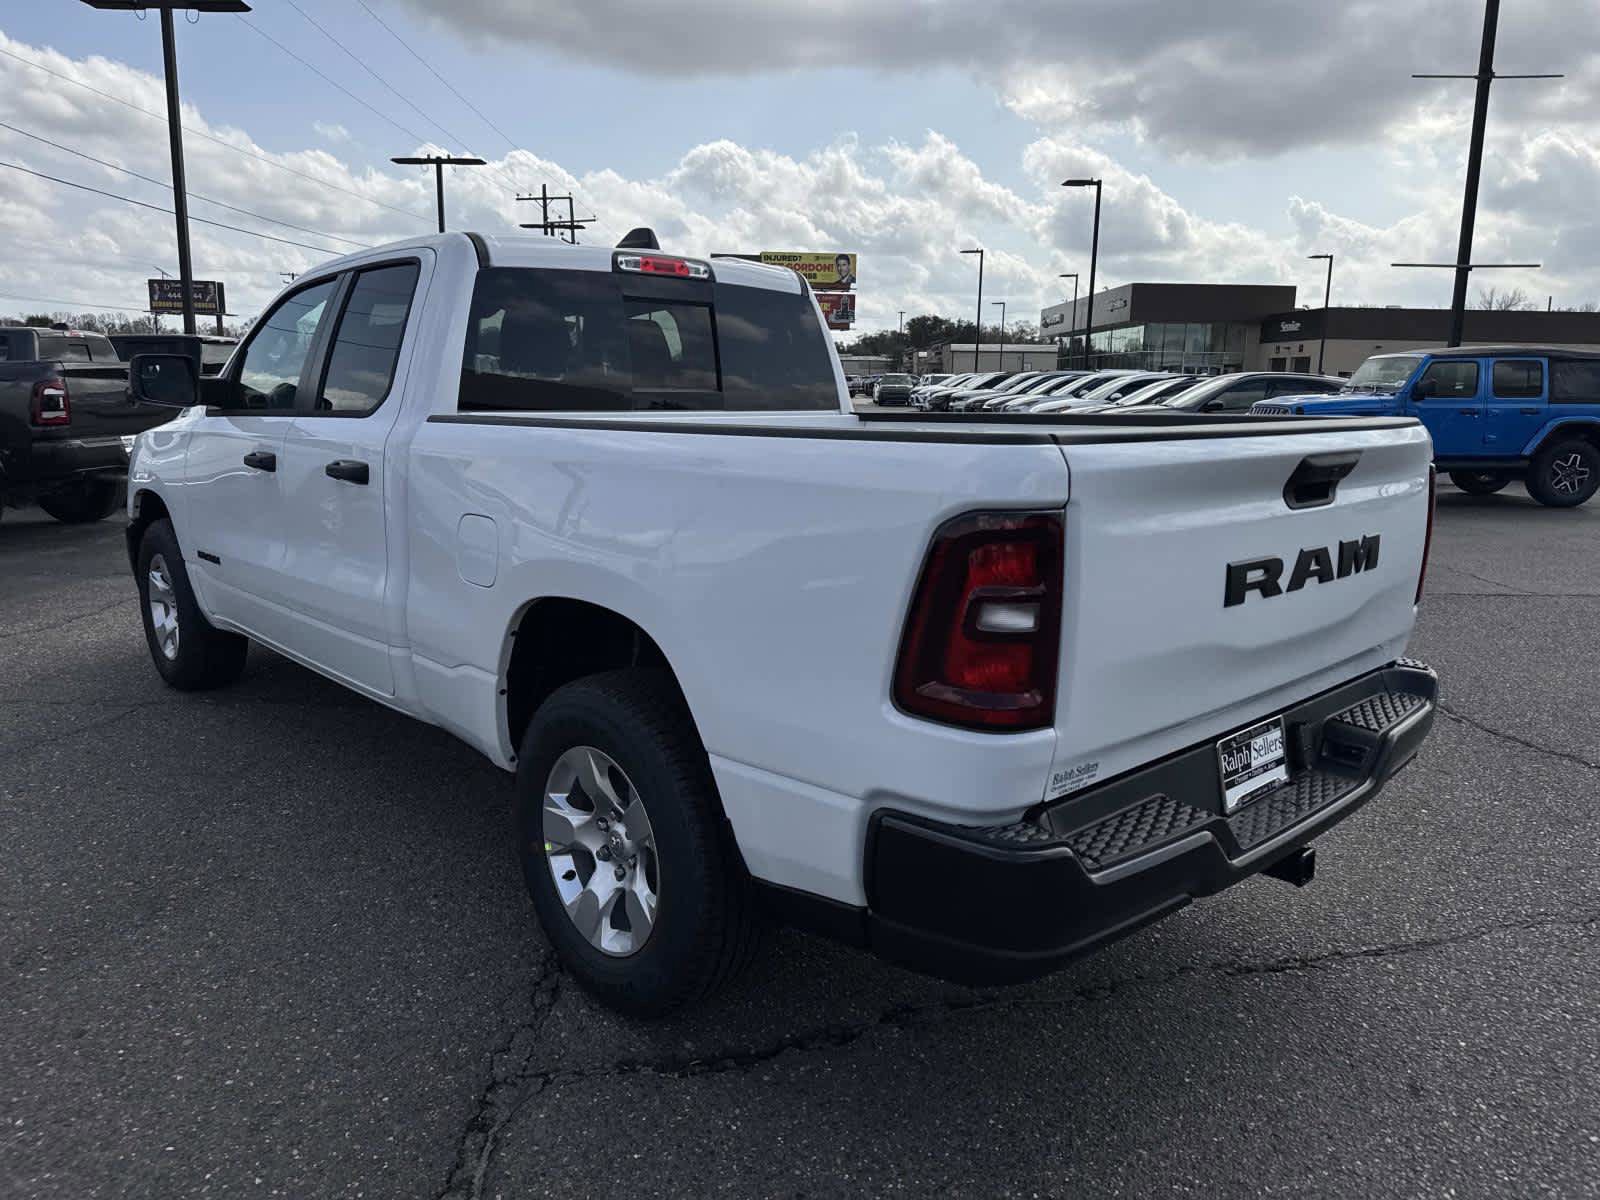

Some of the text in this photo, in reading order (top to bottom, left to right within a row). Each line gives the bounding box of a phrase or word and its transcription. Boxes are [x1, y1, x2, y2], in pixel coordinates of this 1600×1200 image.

[763, 254, 802, 262] INJURED?
[1223, 532, 1381, 608] RAM
[1221, 746, 1250, 774] Ralph
[1252, 735, 1283, 761] Sellers
